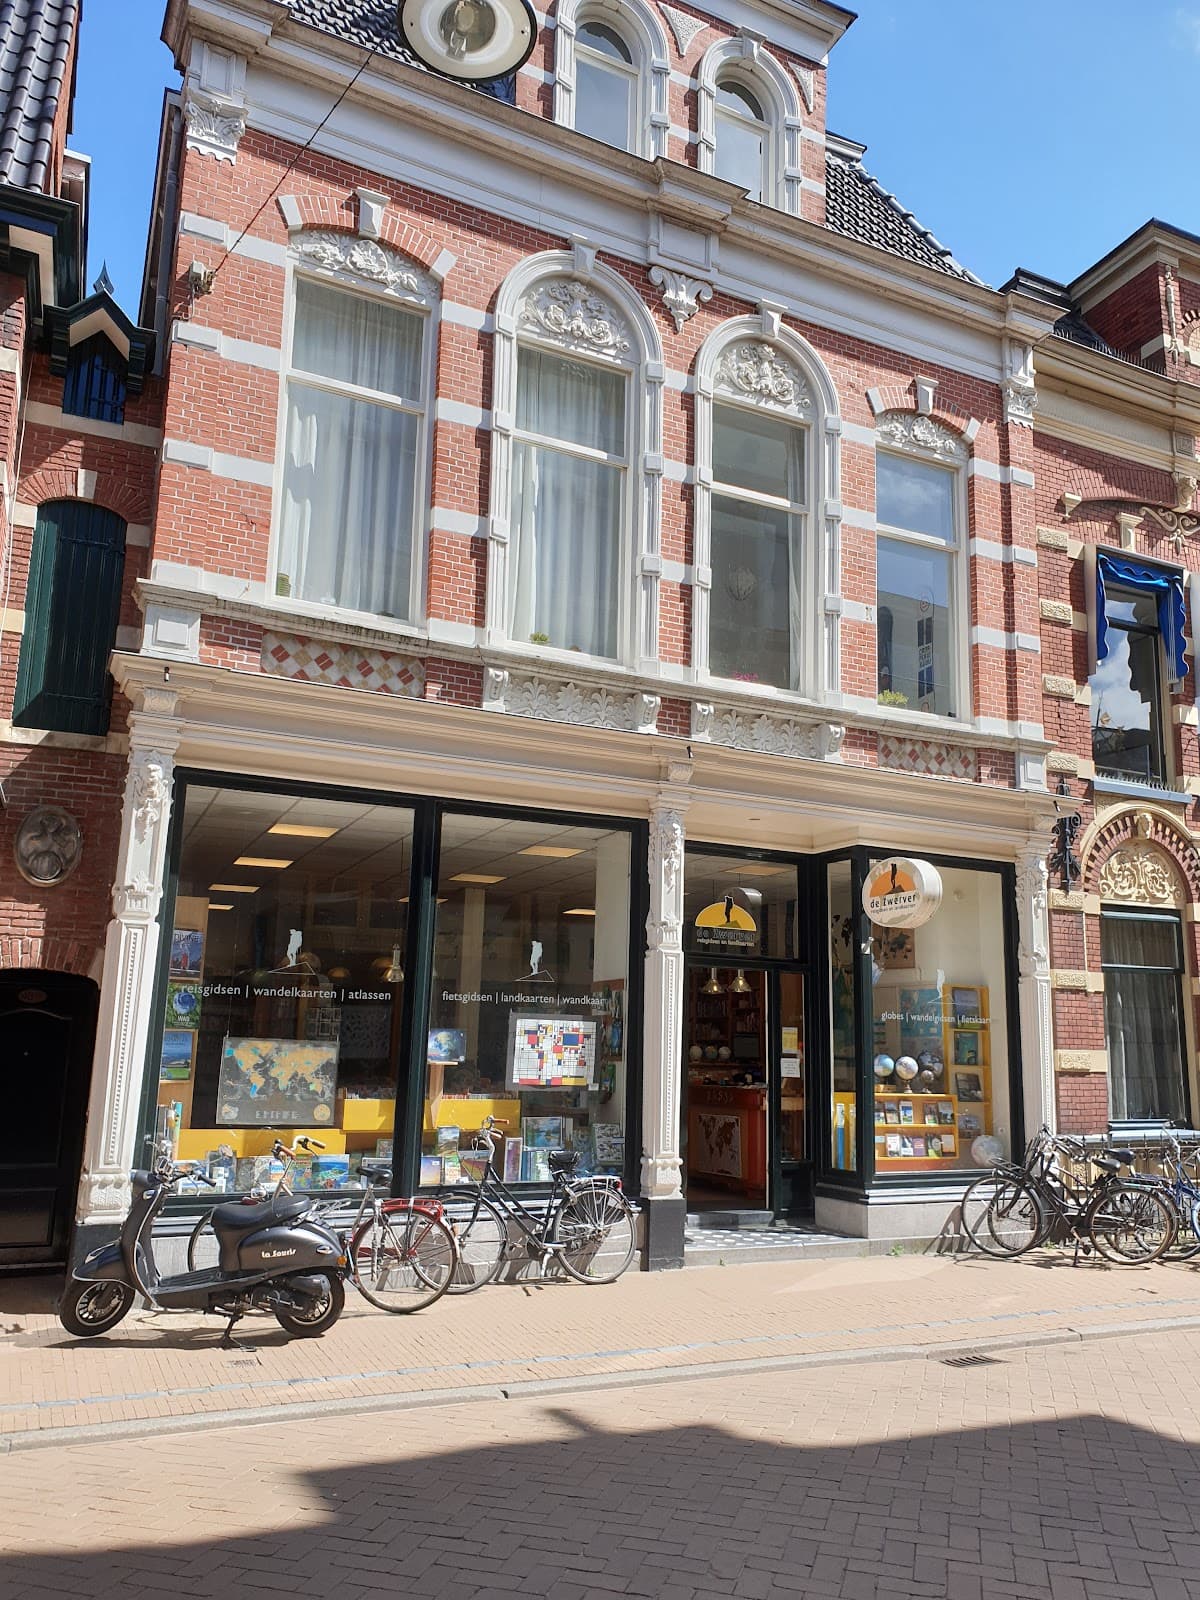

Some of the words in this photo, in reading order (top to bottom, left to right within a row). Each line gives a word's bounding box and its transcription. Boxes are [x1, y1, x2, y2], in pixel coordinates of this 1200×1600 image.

[870, 899, 880, 909] de
[883, 894, 916, 907] Zwerver
[181, 983, 241, 997] reisgidsen
[253, 986, 337, 999] wandelkaarten
[348, 989, 392, 1001] atlassen
[442, 990, 493, 1004] fietsgidsen
[501, 992, 555, 1004] landkaarten
[881, 1010, 904, 1022] globes
[272, 1248, 297, 1258] Souris
